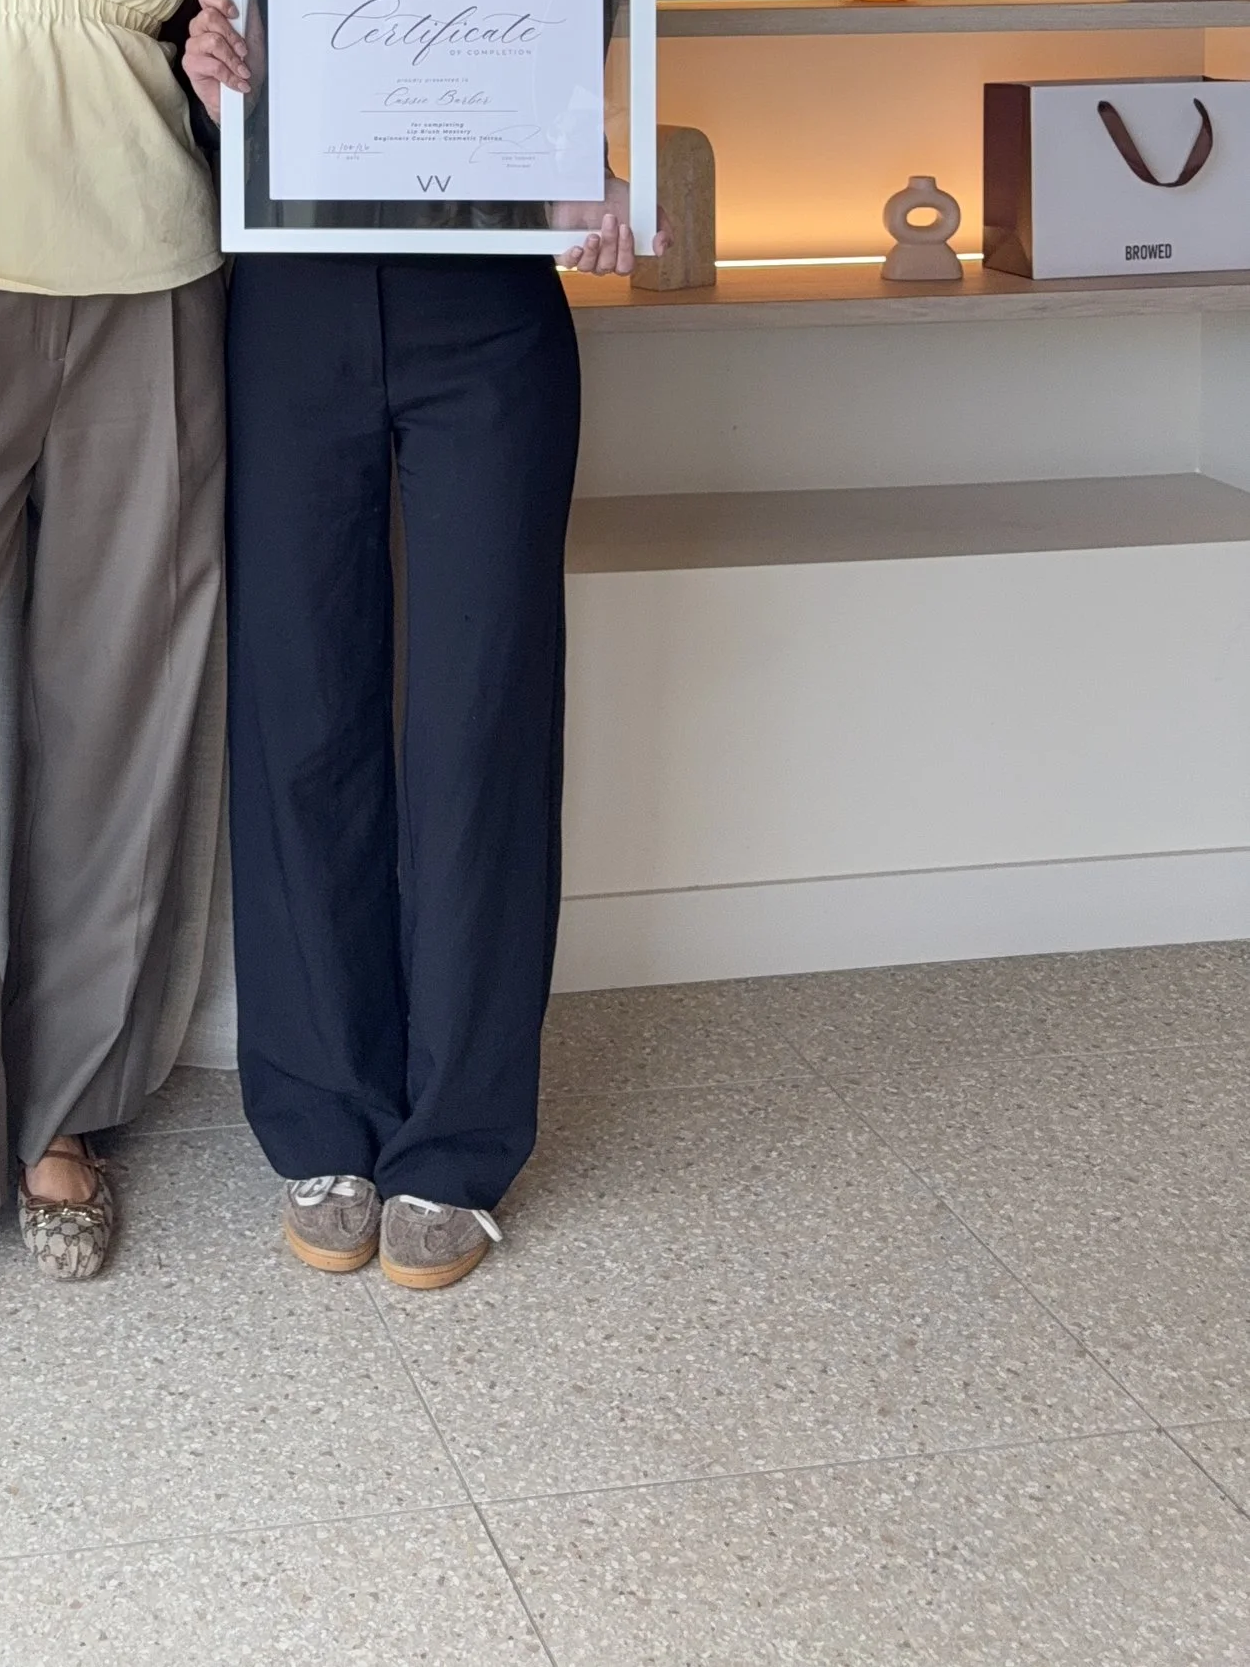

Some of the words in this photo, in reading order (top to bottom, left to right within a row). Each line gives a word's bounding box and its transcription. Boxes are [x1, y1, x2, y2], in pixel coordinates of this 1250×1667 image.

[449, 48, 462, 56] OF
[466, 48, 532, 56] COMPLETION
[1125, 243, 1172, 261] BROWED
